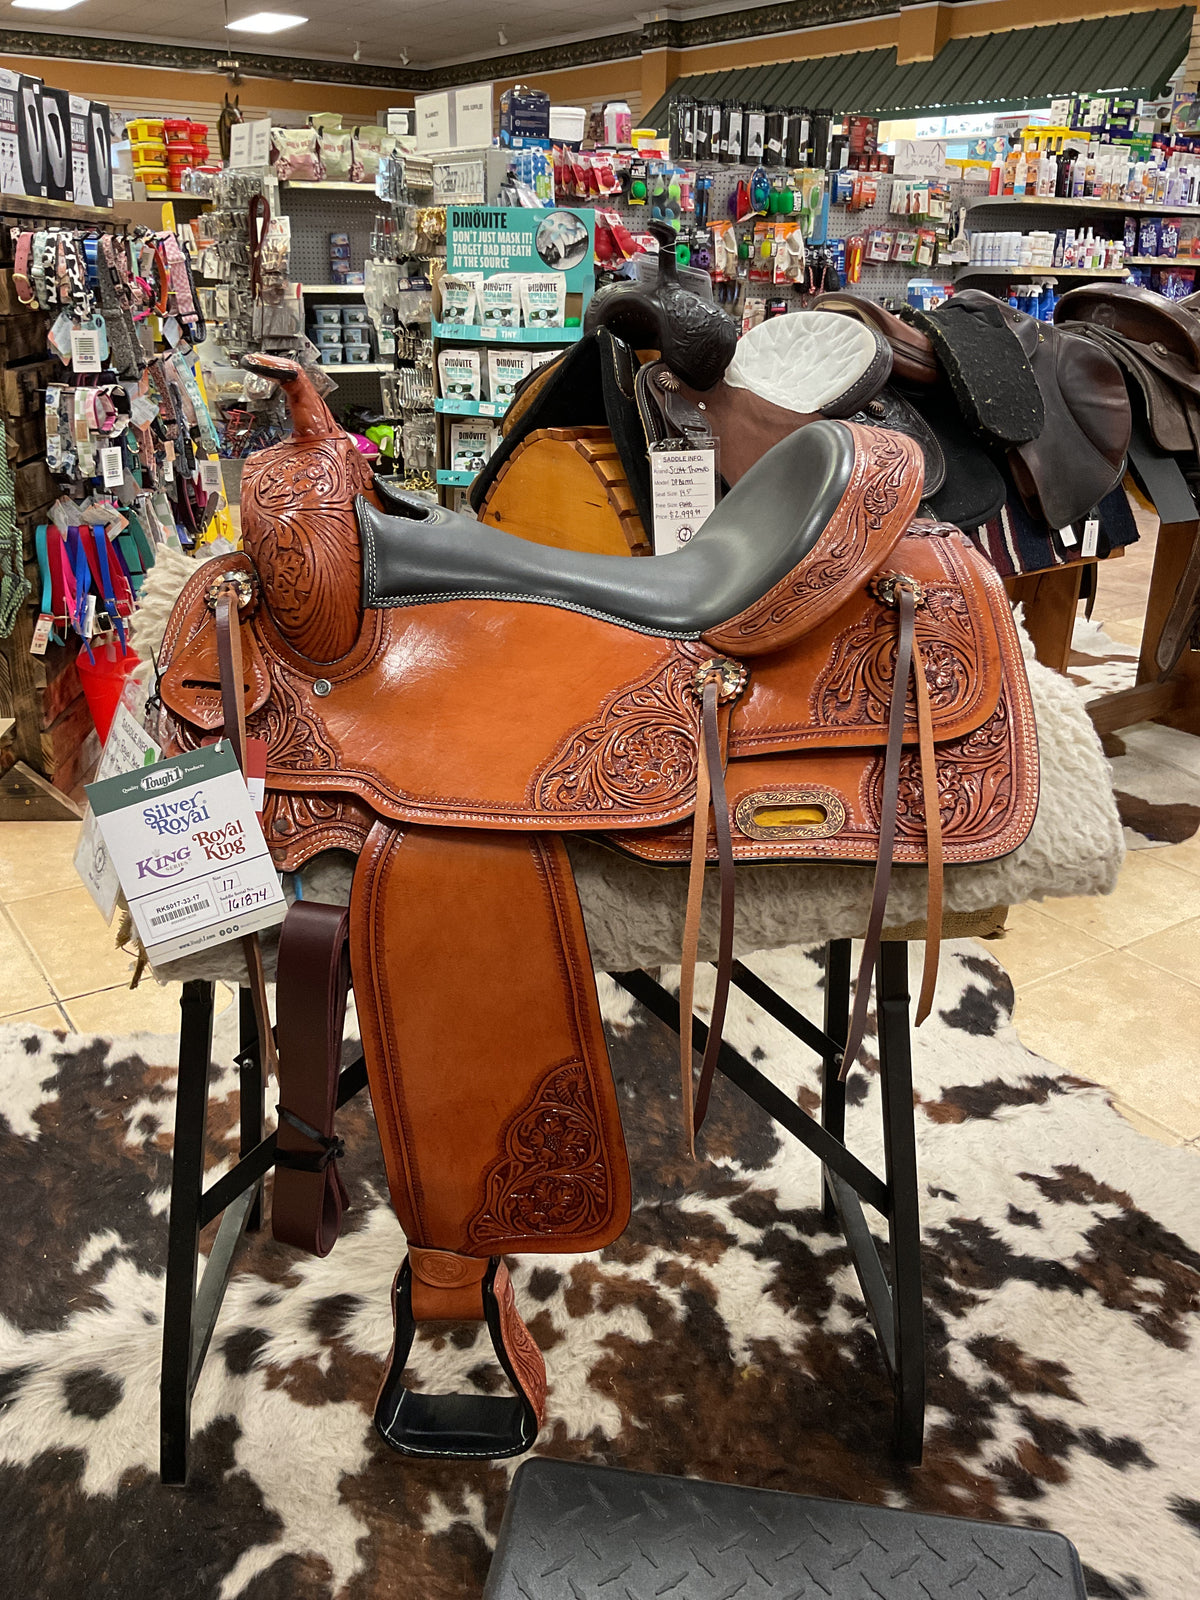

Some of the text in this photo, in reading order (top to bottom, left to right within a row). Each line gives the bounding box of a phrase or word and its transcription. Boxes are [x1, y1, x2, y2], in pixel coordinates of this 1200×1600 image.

[452, 230, 533, 244] DON'T JUST MASK IT!
[452, 243, 532, 257] TARGET BAD BREATH
[452, 256, 510, 269] AT THE SOURCE
[122, 784, 139, 794] Quality
[185, 763, 205, 773] Products
[143, 790, 203, 825] Silver
[151, 804, 211, 835] Royal
[192, 819, 244, 847] Royal
[203, 836, 246, 861] King
[166, 860, 189, 871] SERIES
[223, 879, 234, 891] 17
[156, 894, 200, 914] RK5017-33-17
[228, 888, 267, 912] 161874
